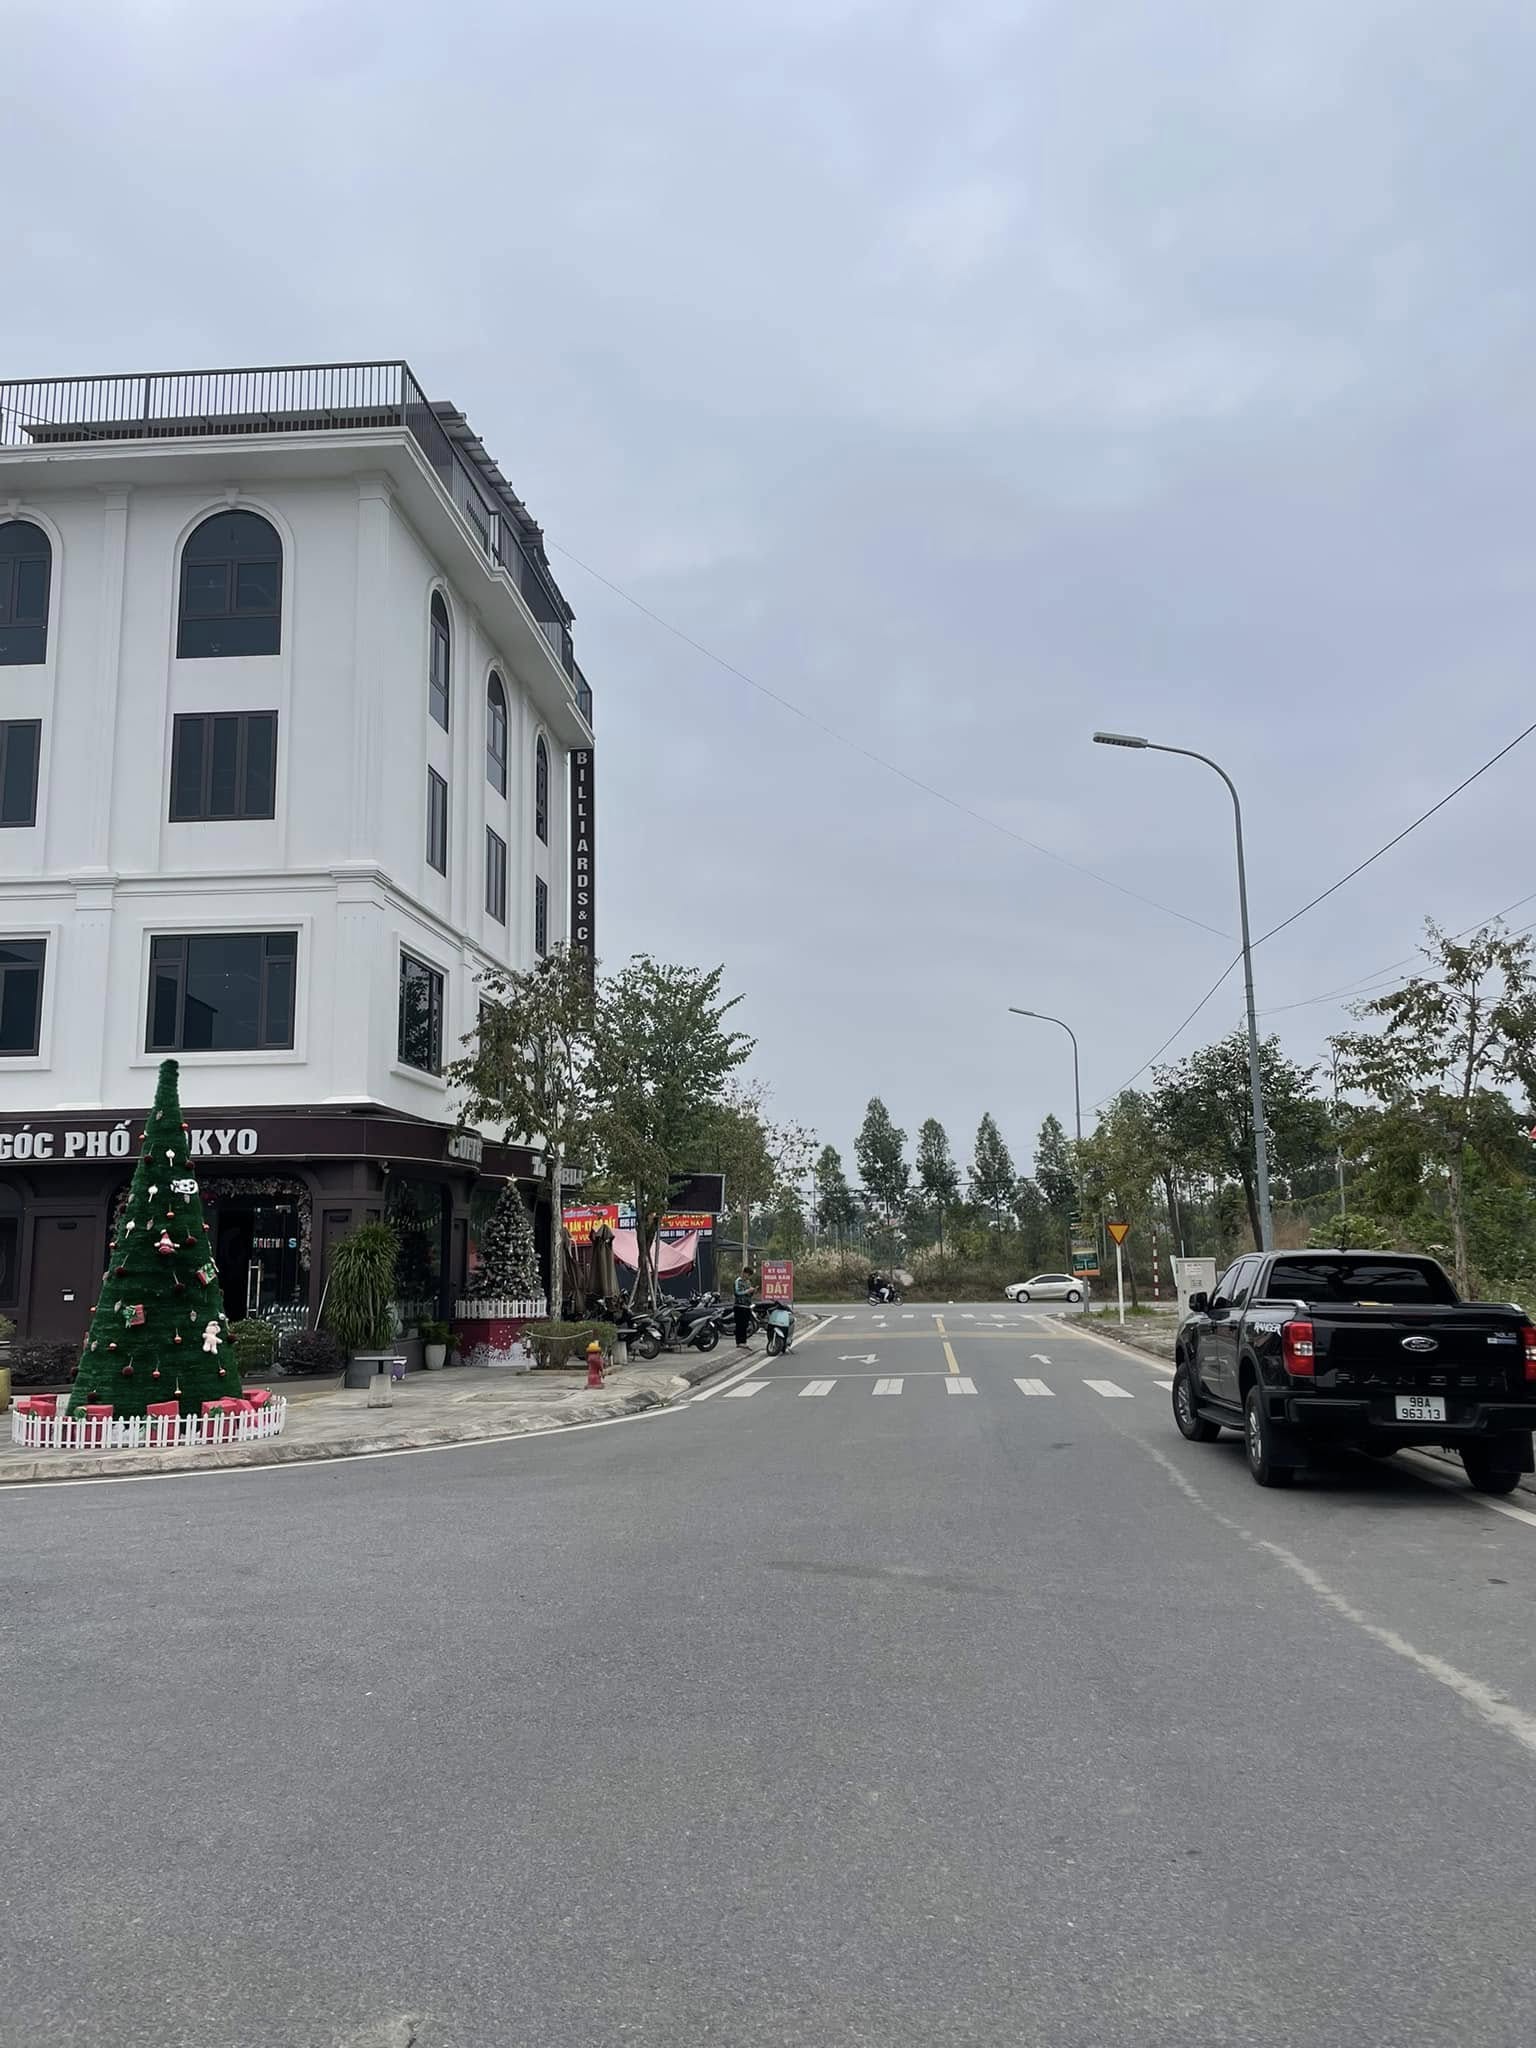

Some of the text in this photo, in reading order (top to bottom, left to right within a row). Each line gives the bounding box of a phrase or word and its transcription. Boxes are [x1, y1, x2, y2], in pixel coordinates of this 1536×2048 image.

[576, 751, 589, 906] BILLIARDS
[64, 1120, 132, 1158] PHỐ
[187, 1129, 258, 1156] KYO
[1401, 1407, 1441, 1420] 963.13
[1409, 1396, 1431, 1408] 98A
